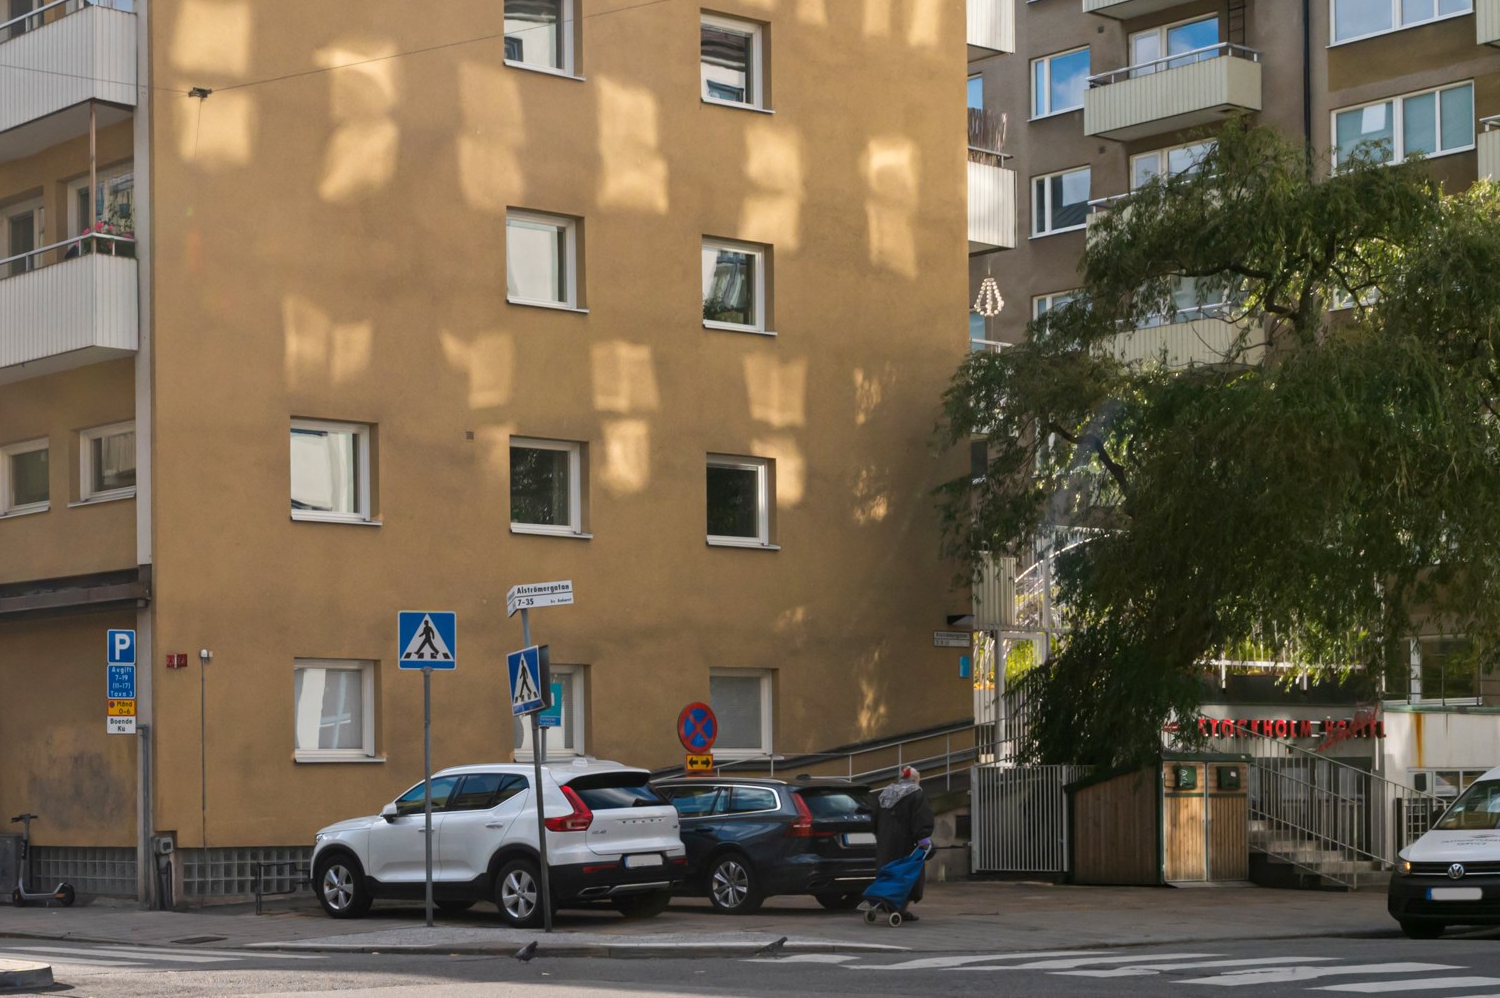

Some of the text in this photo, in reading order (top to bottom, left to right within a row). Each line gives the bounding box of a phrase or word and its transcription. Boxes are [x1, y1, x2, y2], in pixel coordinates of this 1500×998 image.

[517, 584, 569, 594] Alströmergatan
[518, 598, 533, 606] 7-35
[115, 633, 130, 660] P
[111, 666, 132, 674] Avgift
[1197, 718, 1312, 739] STOCKHOLM
